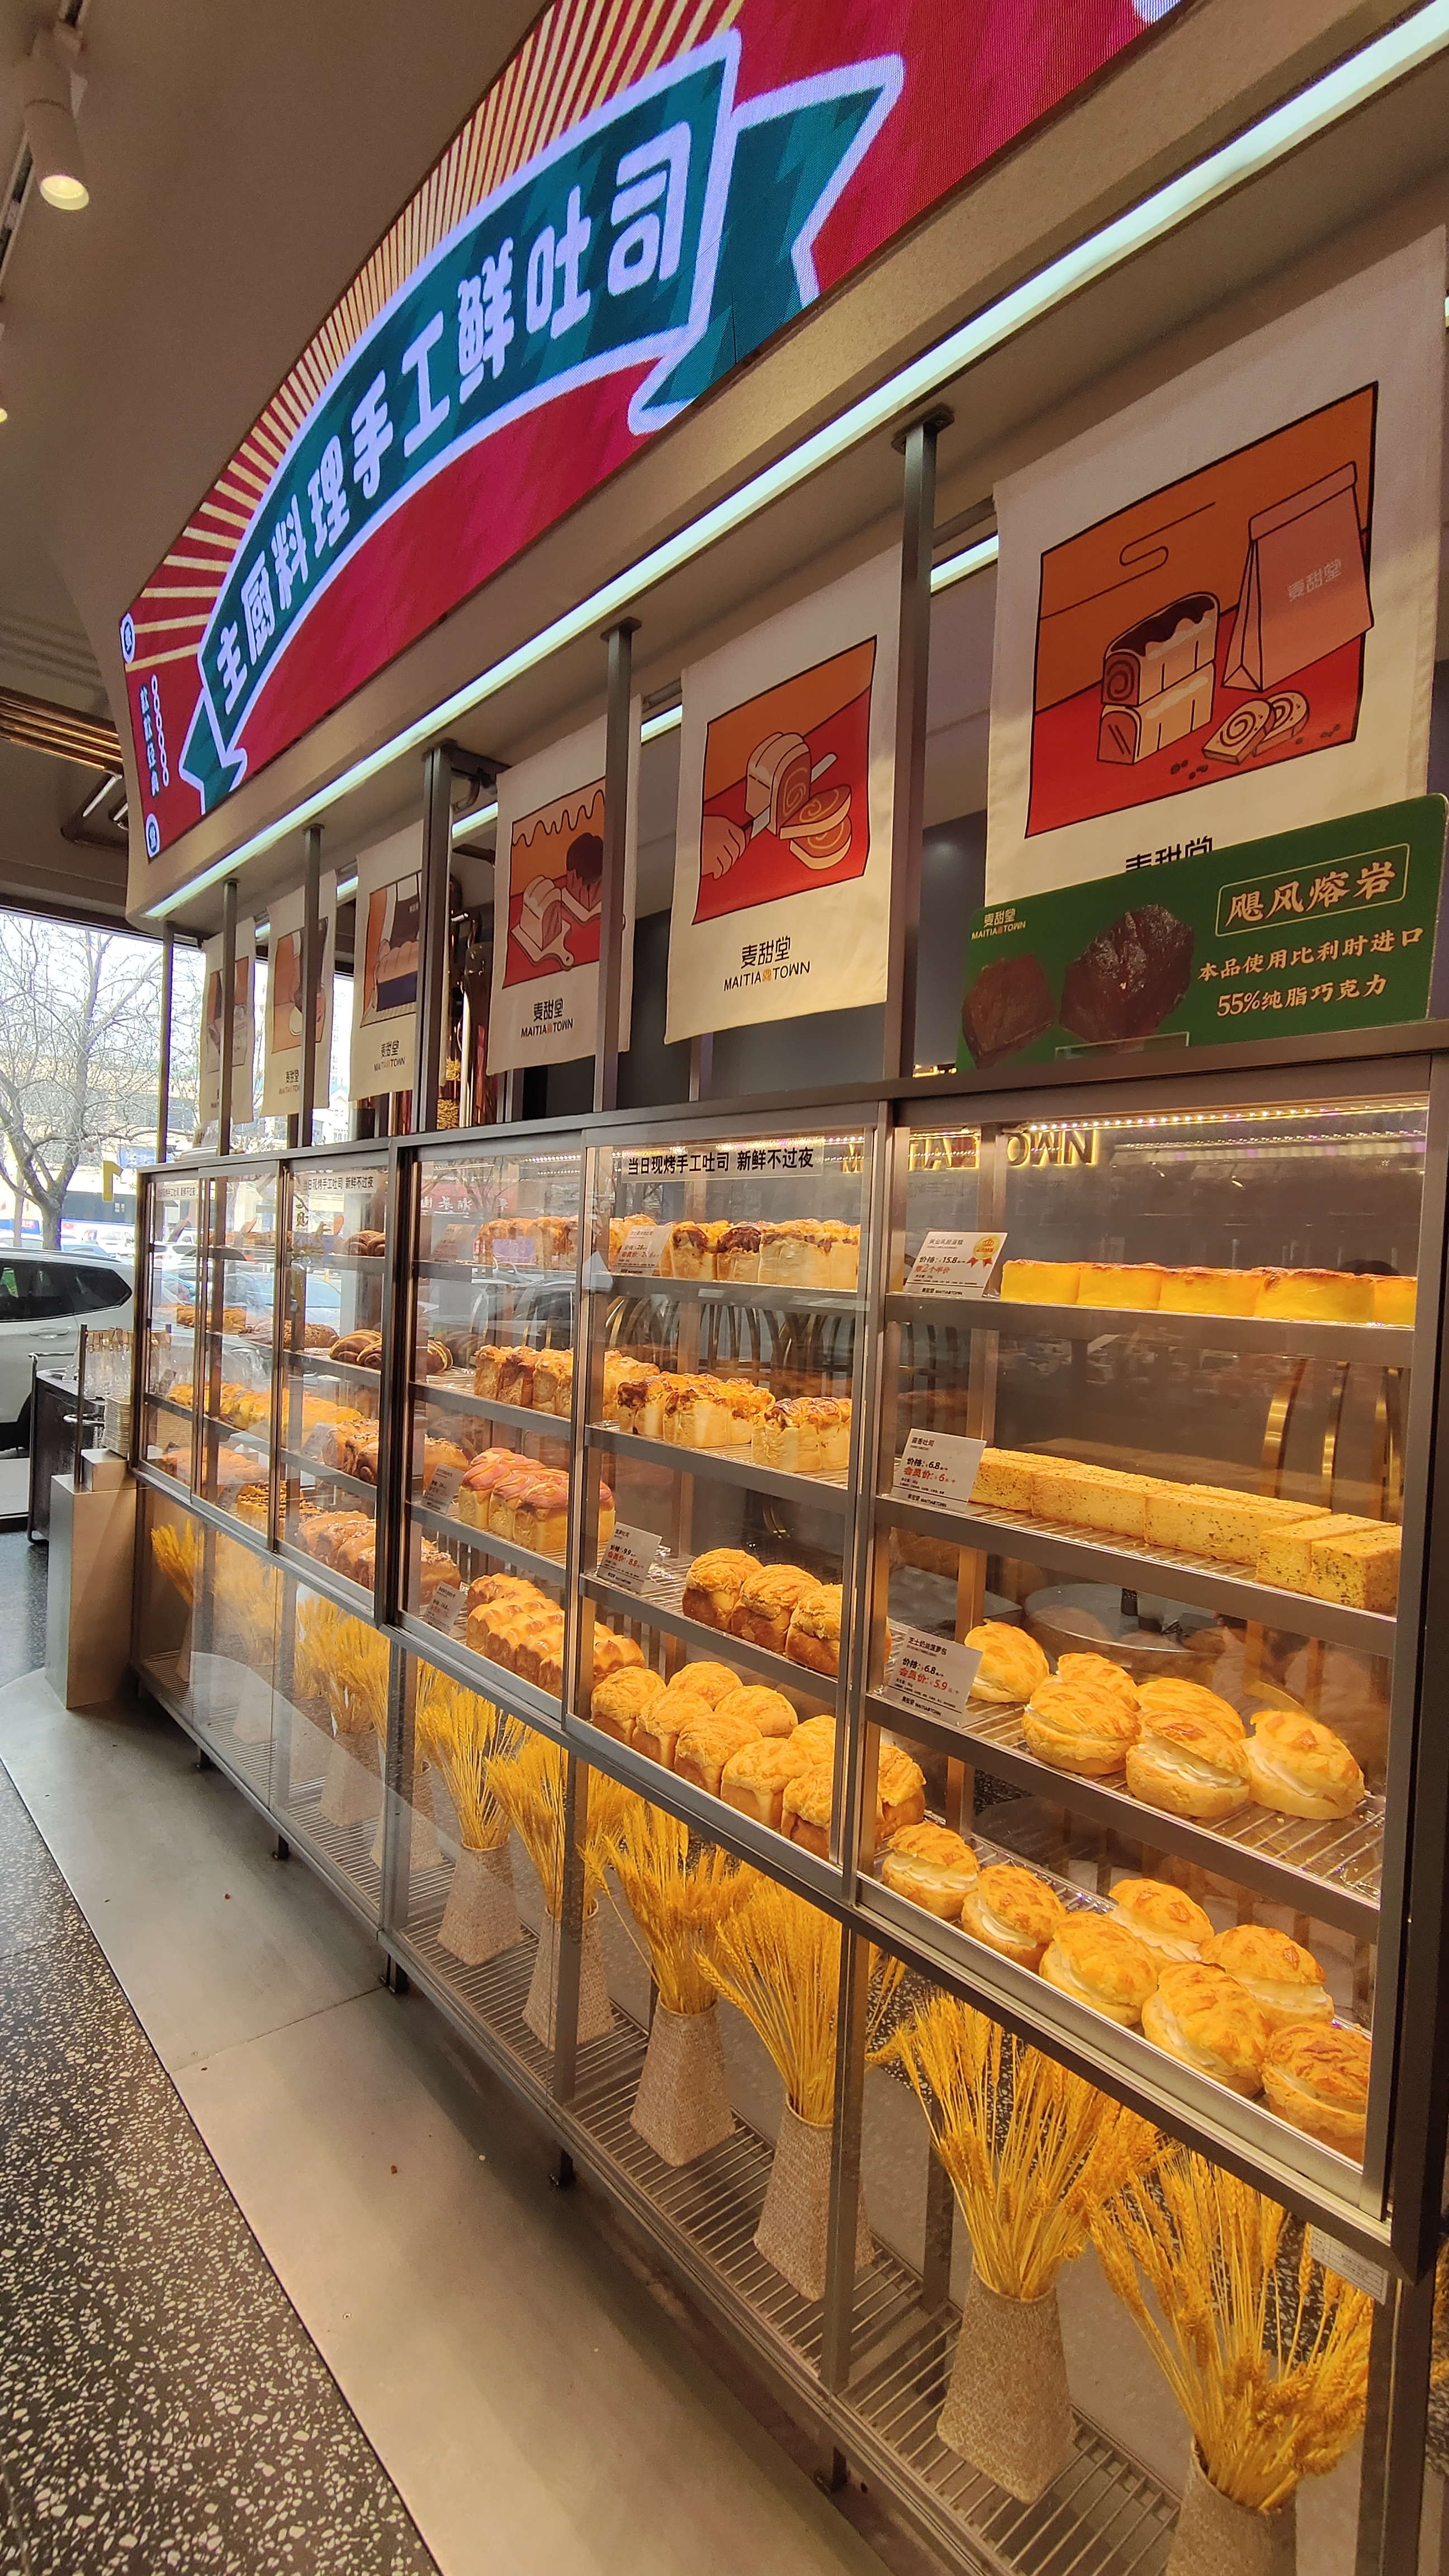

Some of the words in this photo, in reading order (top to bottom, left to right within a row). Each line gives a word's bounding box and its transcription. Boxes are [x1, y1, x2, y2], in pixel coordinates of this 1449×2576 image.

[215, 120, 691, 714] 主厨料理手工鲜吐司
[1287, 558, 1342, 603] 麦甜堂
[1225, 860, 1396, 927] 飓风熔岩
[971, 928, 998, 940] MAITIA
[1003, 920, 1026, 933] TOWN
[983, 907, 1016, 929] 麦甜堂
[741, 935, 791, 969] 麦甜堂
[1198, 927, 1424, 983] 本品使用比利时进口
[723, 971, 761, 992] MAITIA
[772, 960, 811, 981] TOWN
[533, 997, 564, 1022] 麦甜堂
[1217, 974, 1387, 1017] 55%纯脂巧克力
[521, 1024, 547, 1038] MAITIA
[553, 1017, 574, 1033] TOWN
[628, 1152, 730, 1175] 当日现烤手工吐司
[737, 1147, 814, 1172] 新鲜不过夜
